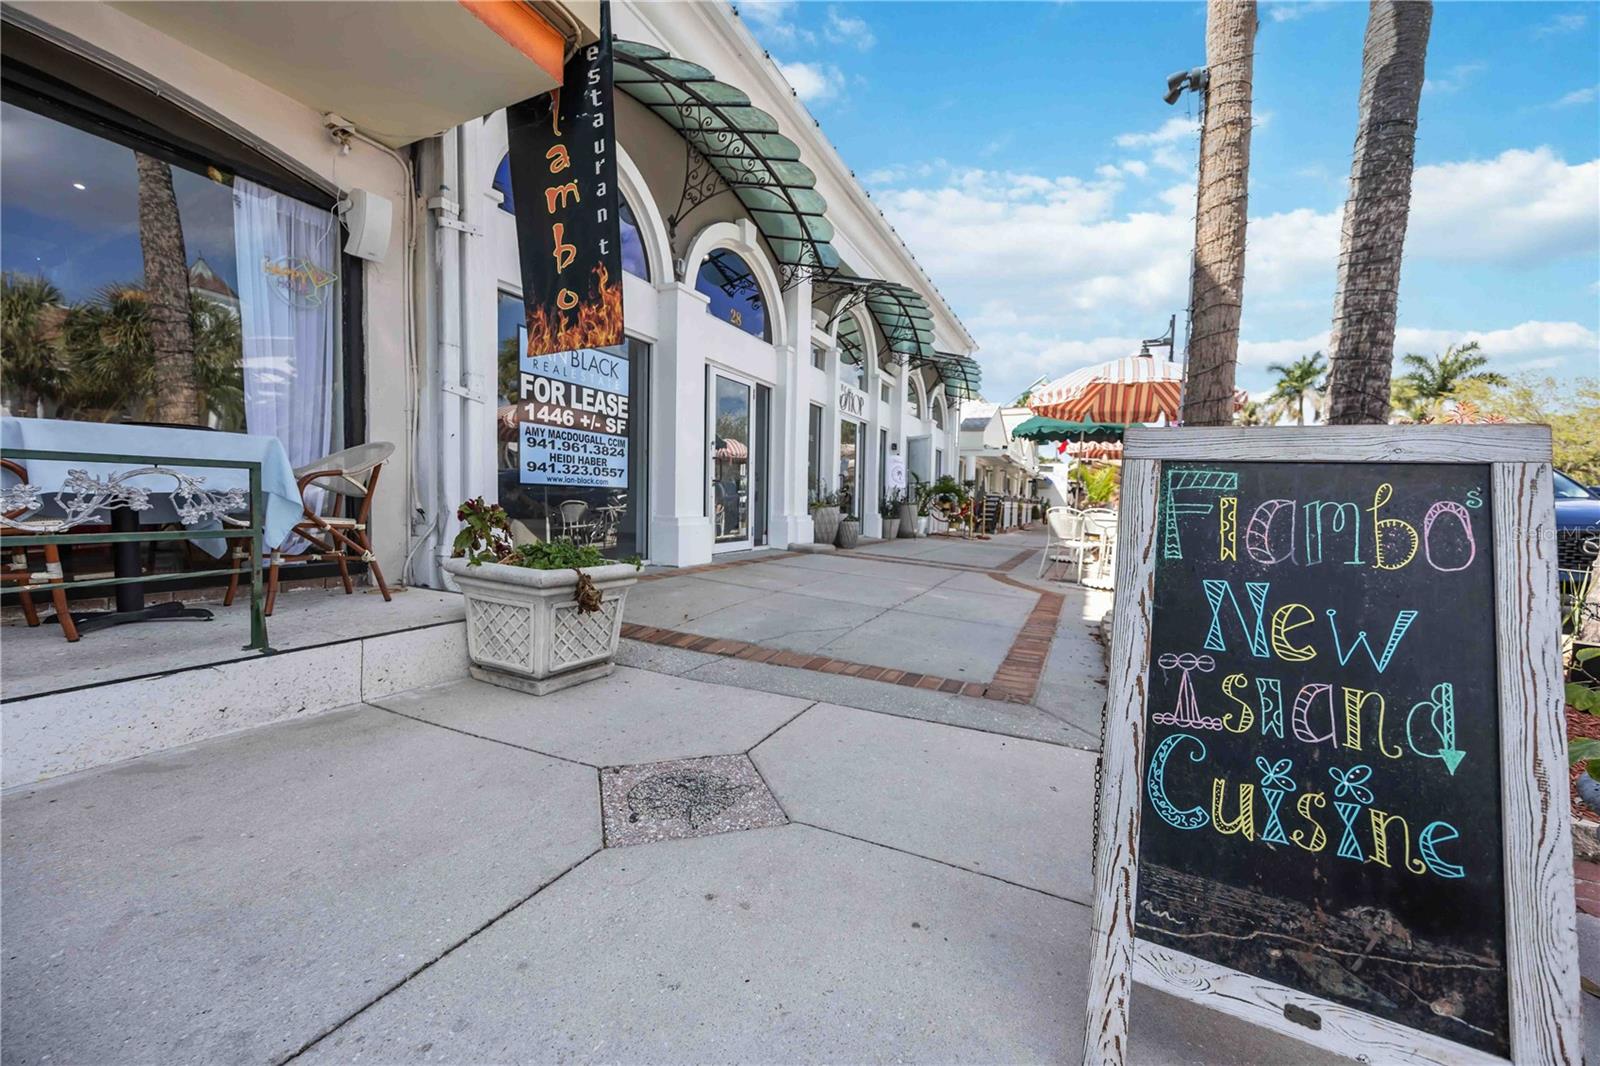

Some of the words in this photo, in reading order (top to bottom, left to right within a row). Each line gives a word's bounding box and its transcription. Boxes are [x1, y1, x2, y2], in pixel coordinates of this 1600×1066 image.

[586, 45, 609, 255] estaurant
[545, 88, 580, 310] lambo
[533, 358, 567, 377] REAL
[570, 349, 620, 380] BLACK
[520, 372, 566, 407] FOR
[570, 384, 629, 420] LEASE
[524, 402, 575, 427] 1446
[580, 414, 601, 430] +/-
[605, 417, 627, 434] SF
[525, 426, 546, 438] AMY
[607, 438, 626, 448] CCIM
[526, 436, 625, 458] 941.961.3824
[526, 461, 625, 478] 941.323.0557
[549, 453, 576, 465] HEIDI
[577, 456, 608, 467] HABER
[1202, 579, 1419, 674] New
[1152, 653, 1466, 775] Island
[1147, 733, 1465, 878] Cuisine
